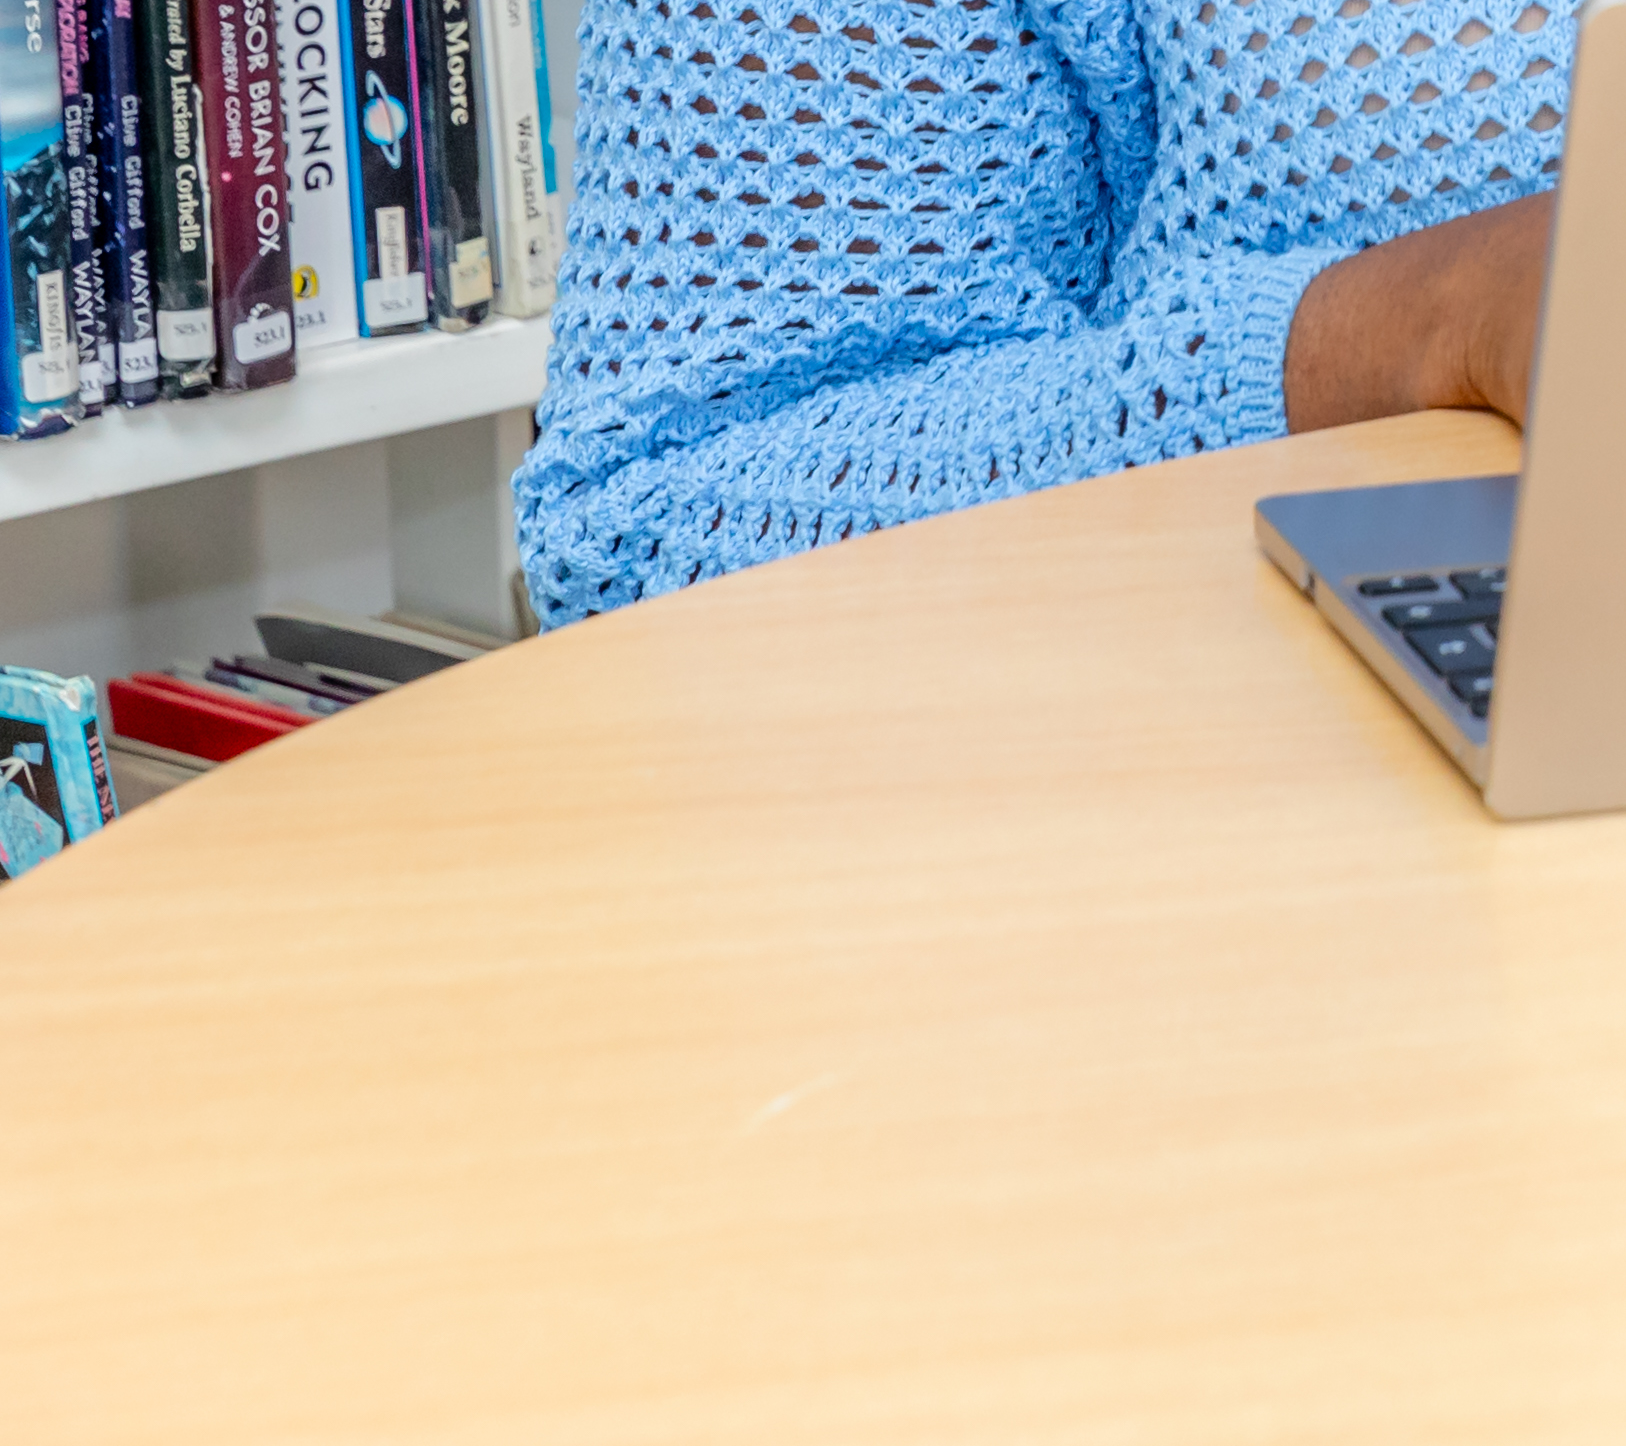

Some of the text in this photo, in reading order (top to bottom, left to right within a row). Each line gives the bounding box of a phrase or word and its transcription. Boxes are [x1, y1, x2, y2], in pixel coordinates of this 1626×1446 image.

[165, 47, 188, 75] by
[218, 4, 244, 159] & ANDREW COHEN
[444, 20, 470, 128] Moore
[121, 94, 146, 230] Clive Gifford
[170, 75, 192, 159] Luciano
[248, 80, 276, 177] BRIAN
[64, 105, 91, 241] Clive Gifford
[174, 164, 202, 252] Corbella
[516, 114, 539, 222] Wayland
[254, 182, 281, 258] COX
[72, 260, 97, 362] WAYLAN
[129, 249, 151, 340] WAYLA
